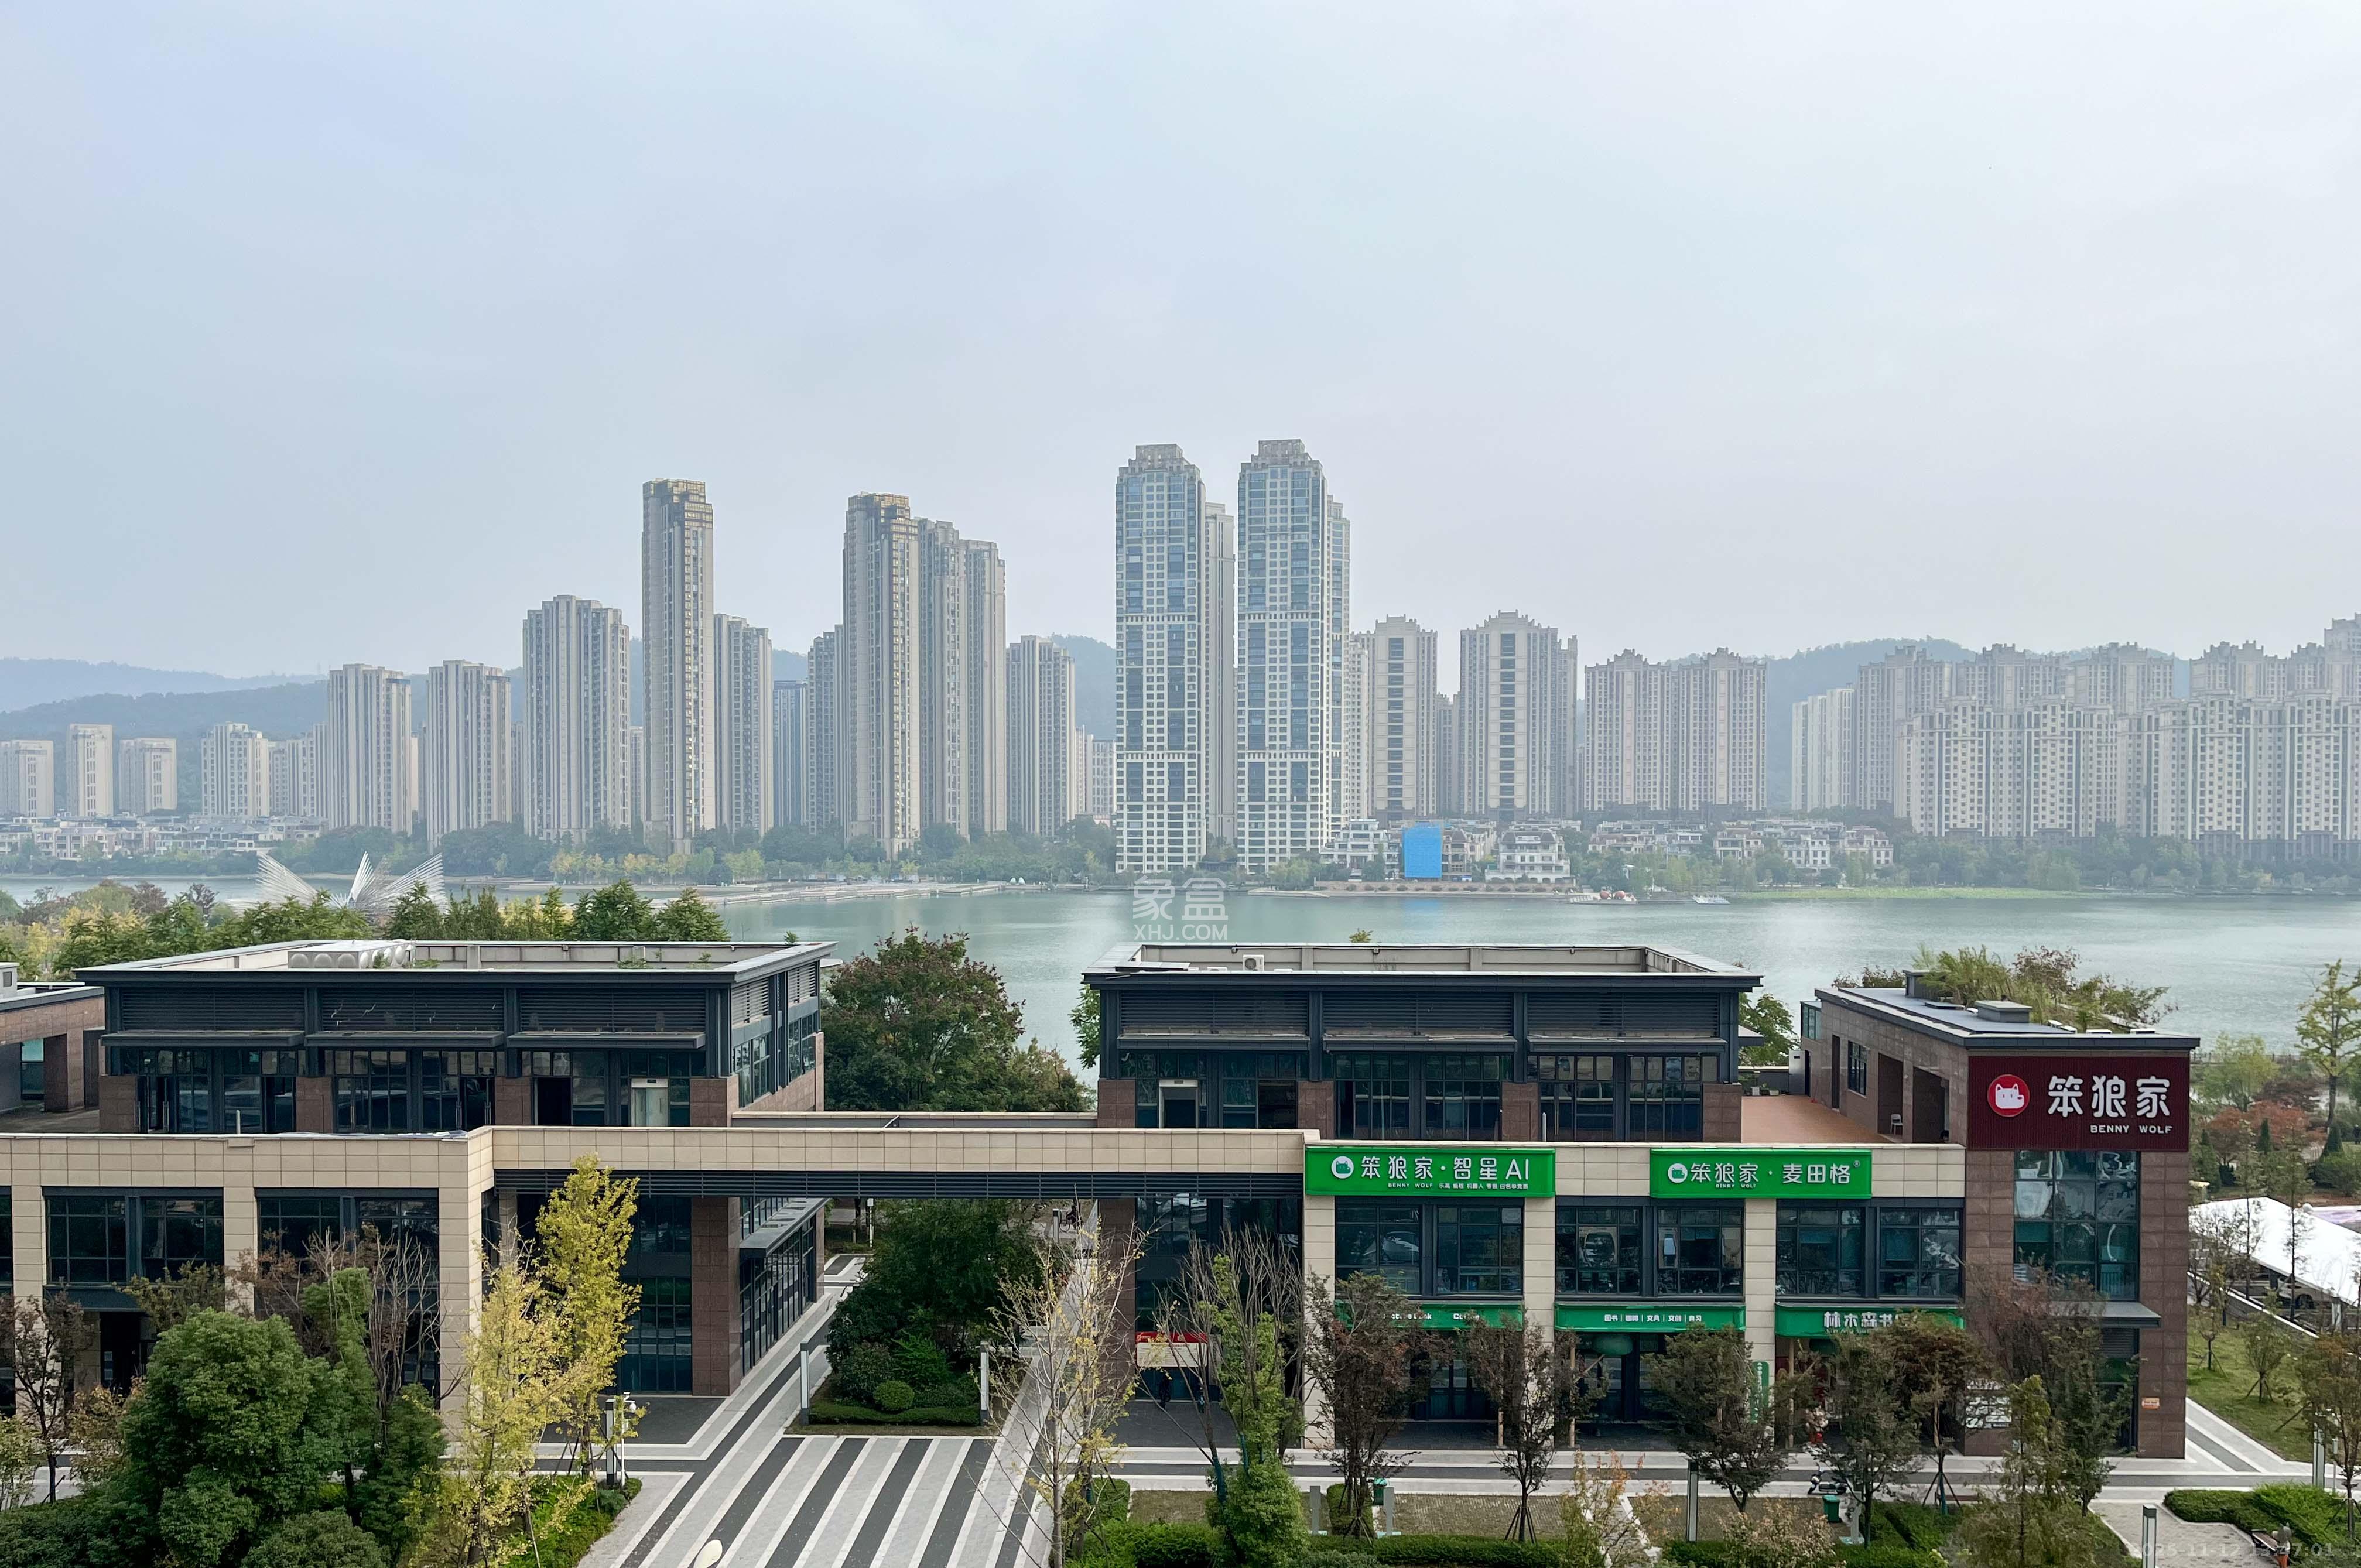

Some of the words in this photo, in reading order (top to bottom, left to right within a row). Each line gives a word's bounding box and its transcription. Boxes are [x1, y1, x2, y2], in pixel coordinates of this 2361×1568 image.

[2048, 1075, 2170, 1118] 笨狼家
[2090, 1125, 2130, 1134] BENNY
[2139, 1125, 2173, 1134] WOLF
